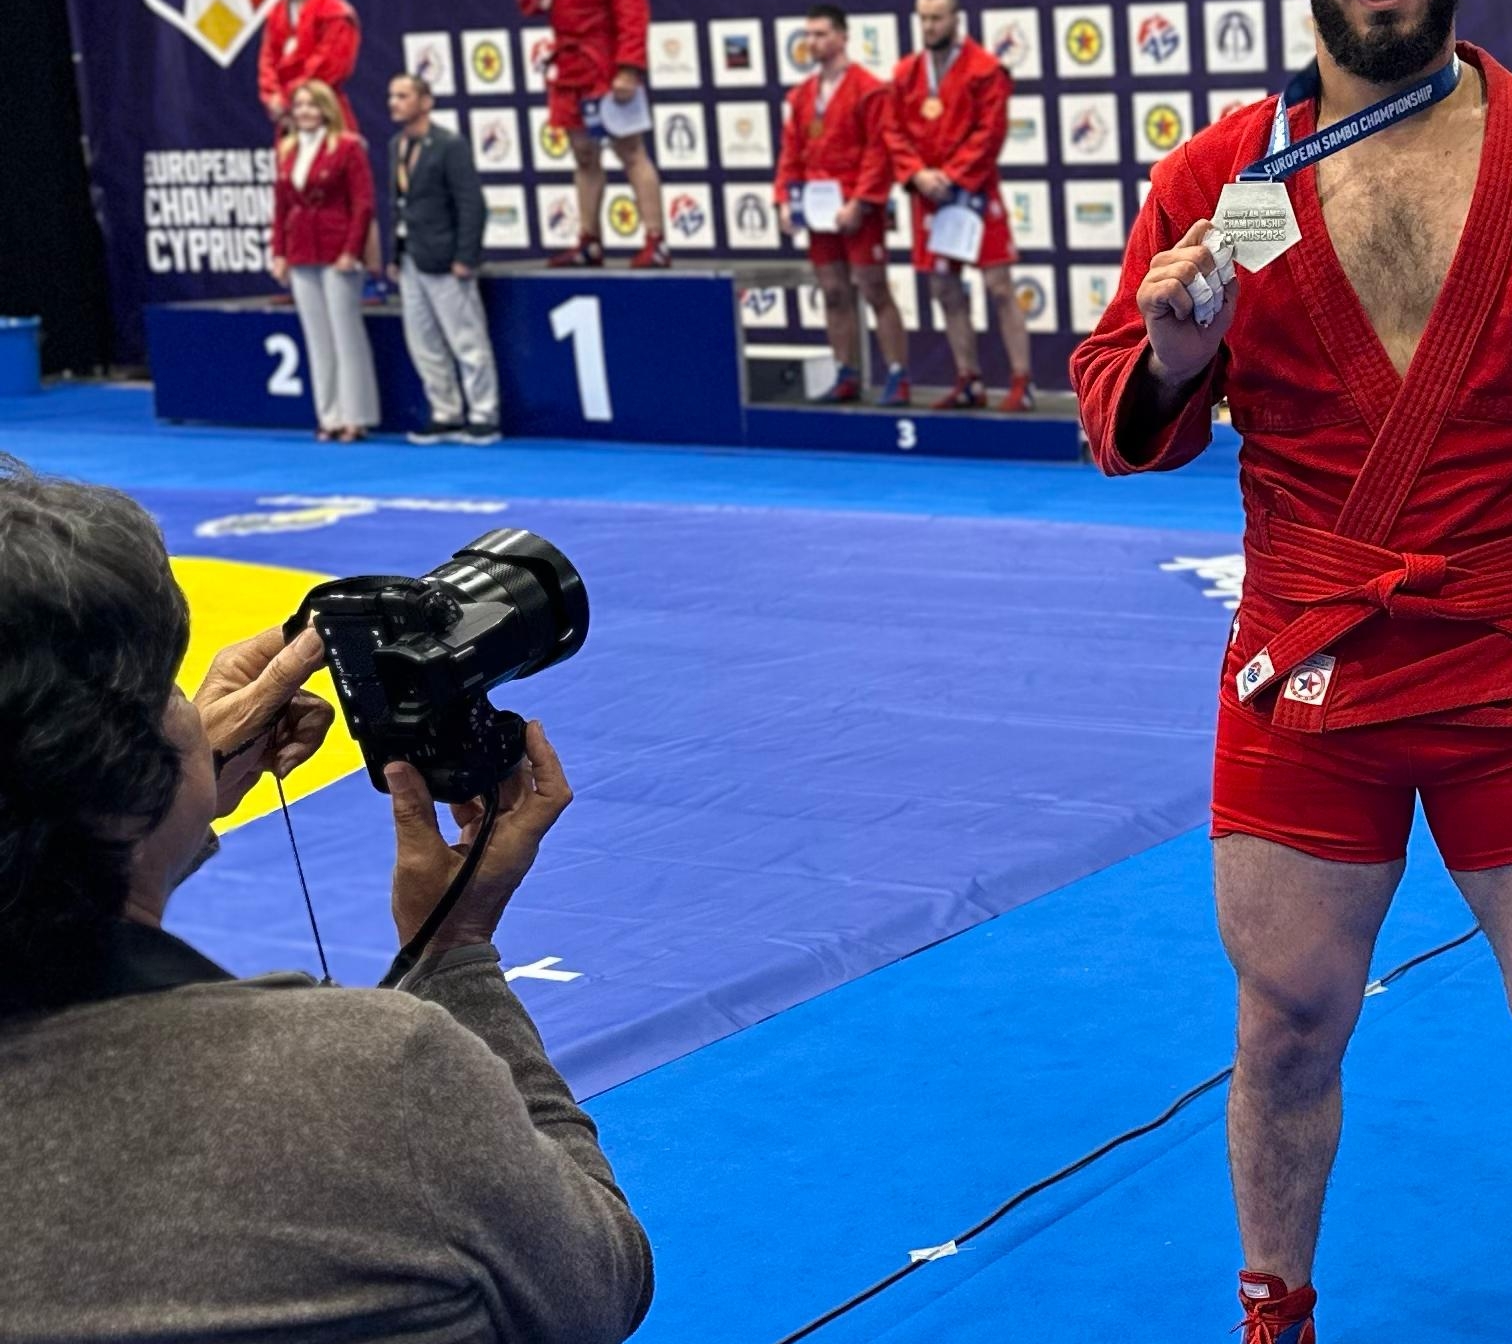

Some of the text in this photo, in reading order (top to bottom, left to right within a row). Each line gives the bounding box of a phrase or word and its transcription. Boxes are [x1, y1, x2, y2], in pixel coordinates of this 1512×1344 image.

[1263, 83, 1434, 178] EUROPEAN SAMBO CHAMPIONSHIP
[144, 150, 249, 185] EUROPEAN
[263, 333, 304, 397] 2
[548, 295, 613, 422] 1
[897, 419, 918, 450] 3
